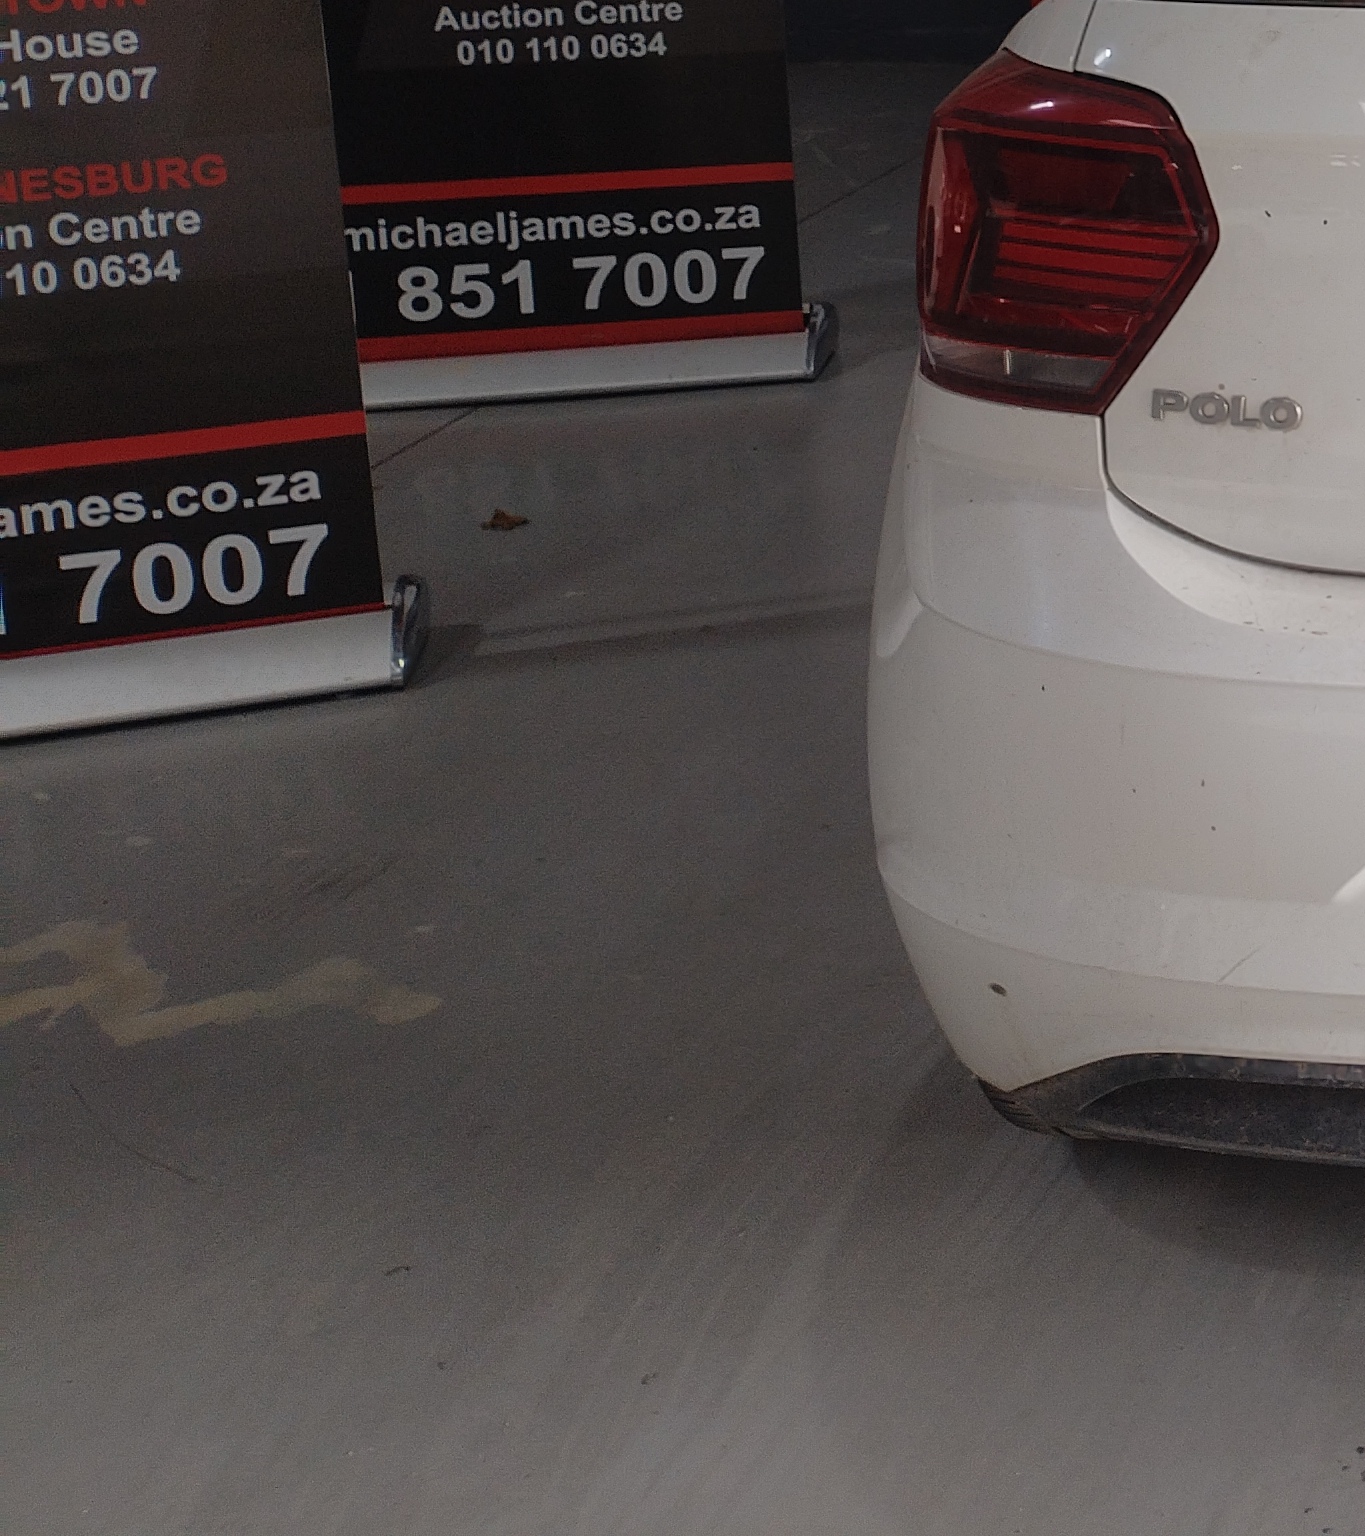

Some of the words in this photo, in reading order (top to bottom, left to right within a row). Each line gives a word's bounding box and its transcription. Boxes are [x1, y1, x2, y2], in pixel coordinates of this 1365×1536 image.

[434, 2, 564, 32] Auction
[456, 38, 515, 66] 010
[525, 35, 580, 62] 110
[590, 31, 668, 59] 0634
[49, 66, 158, 106] 7007
[48, 207, 201, 246] Centre
[343, 204, 761, 252] michaeljames.co.za
[73, 249, 181, 290] 0634
[397, 259, 535, 322] 851
[572, 245, 765, 310] 7007
[1151, 388, 1303, 432] POLO
[58, 523, 329, 624] 7007
